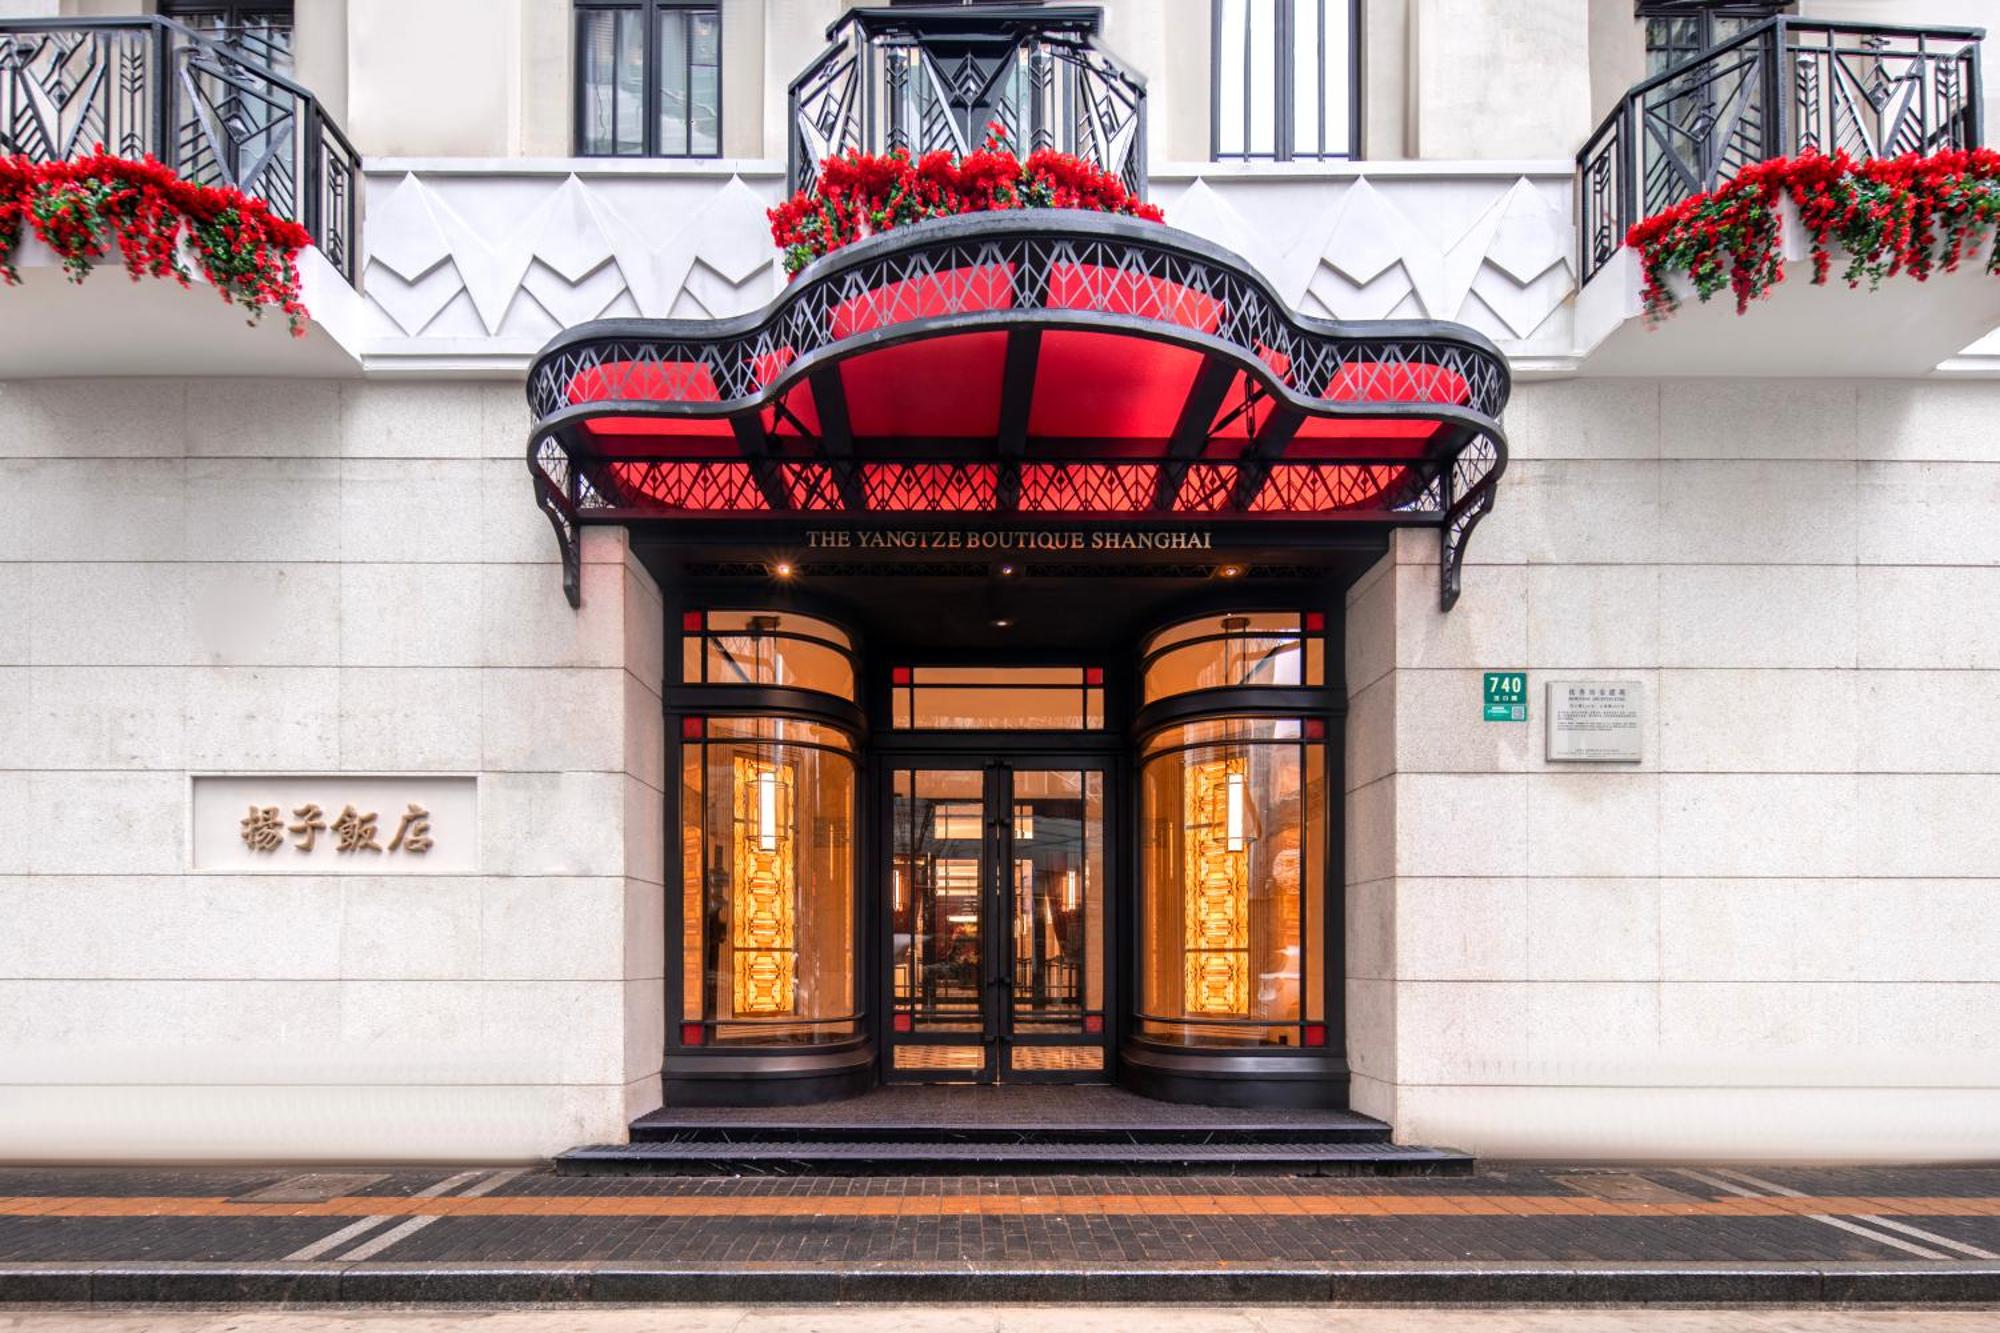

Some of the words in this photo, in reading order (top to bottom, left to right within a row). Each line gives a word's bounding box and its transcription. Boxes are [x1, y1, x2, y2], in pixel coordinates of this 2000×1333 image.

[806, 531, 851, 548] THE
[857, 531, 962, 548] YANGTZE
[966, 531, 1085, 549] BOUTIQUE
[1091, 532, 1212, 549] SHANGHAI
[1489, 676, 1521, 693] 740
